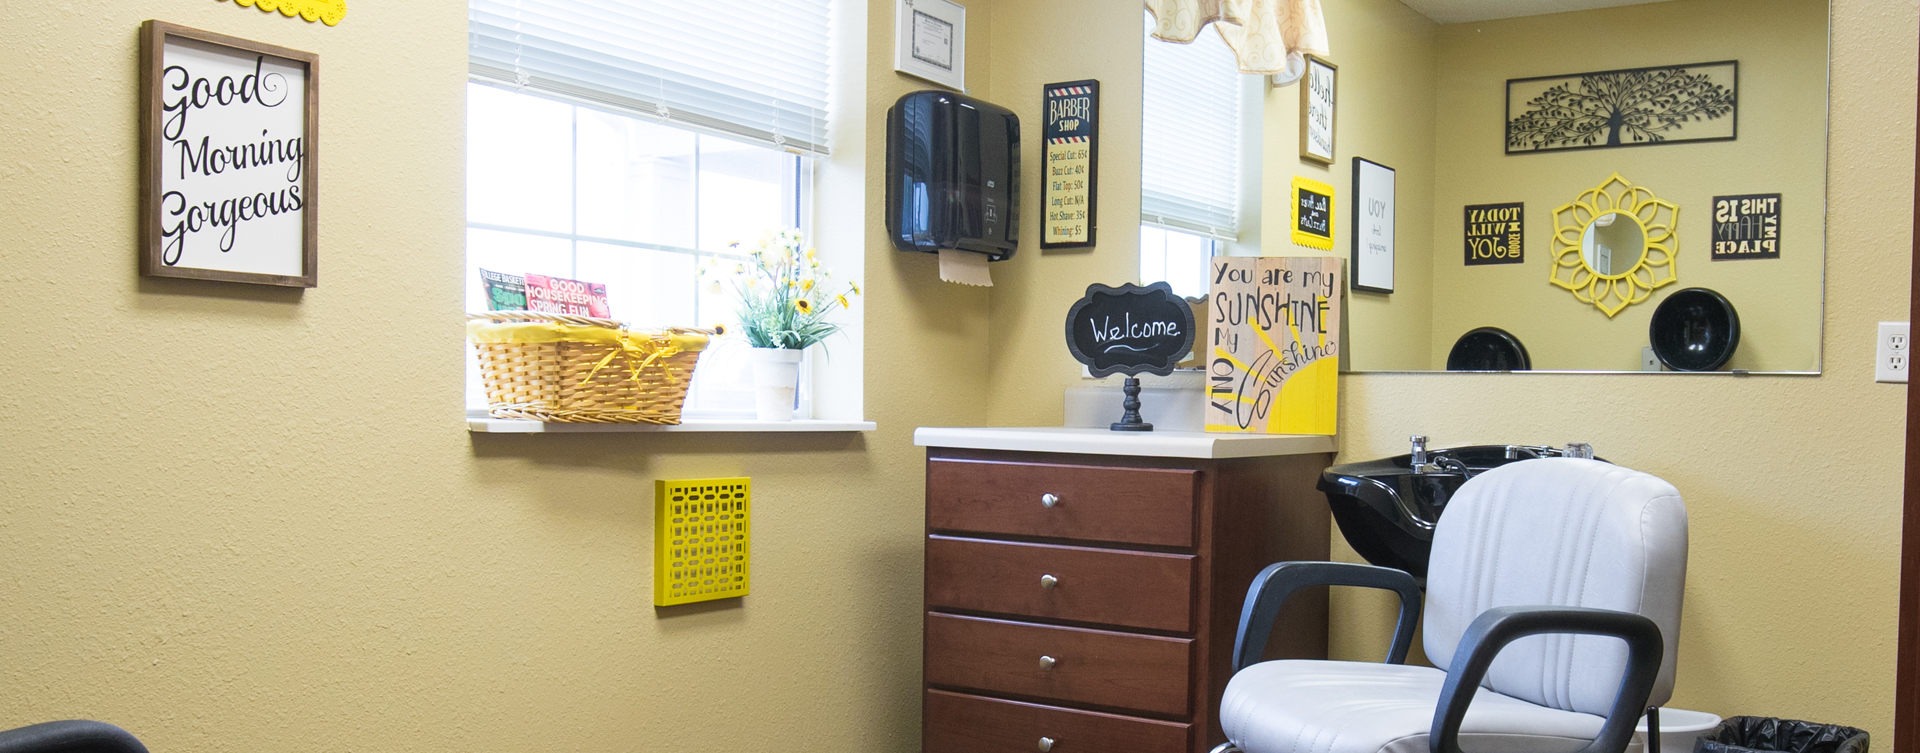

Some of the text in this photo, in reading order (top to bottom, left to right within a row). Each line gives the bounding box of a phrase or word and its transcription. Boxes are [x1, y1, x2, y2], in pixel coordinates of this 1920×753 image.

[162, 55, 289, 141] Good
[1050, 96, 1090, 126] BARBER
[1058, 119, 1080, 132] SHOP
[172, 129, 304, 182] Morning
[1050, 151, 1066, 163] Special
[1052, 166, 1063, 176] Buzz
[1053, 181, 1062, 191] Flat
[1052, 196, 1063, 208] Long
[1075, 194, 1084, 206] N/A
[161, 184, 304, 267] Gorgeous
[1050, 211, 1058, 221] Hot
[549, 278, 585, 294] GOOD
[1214, 262, 1334, 299] You are my
[526, 284, 608, 306] HOUSEKEEPING
[530, 299, 567, 315] SPRING
[1216, 286, 1330, 334] SUNSHINE
[1089, 311, 1181, 343] Welcome
[1211, 357, 1235, 415] ONLY
[1236, 340, 1337, 430] Sunshine
